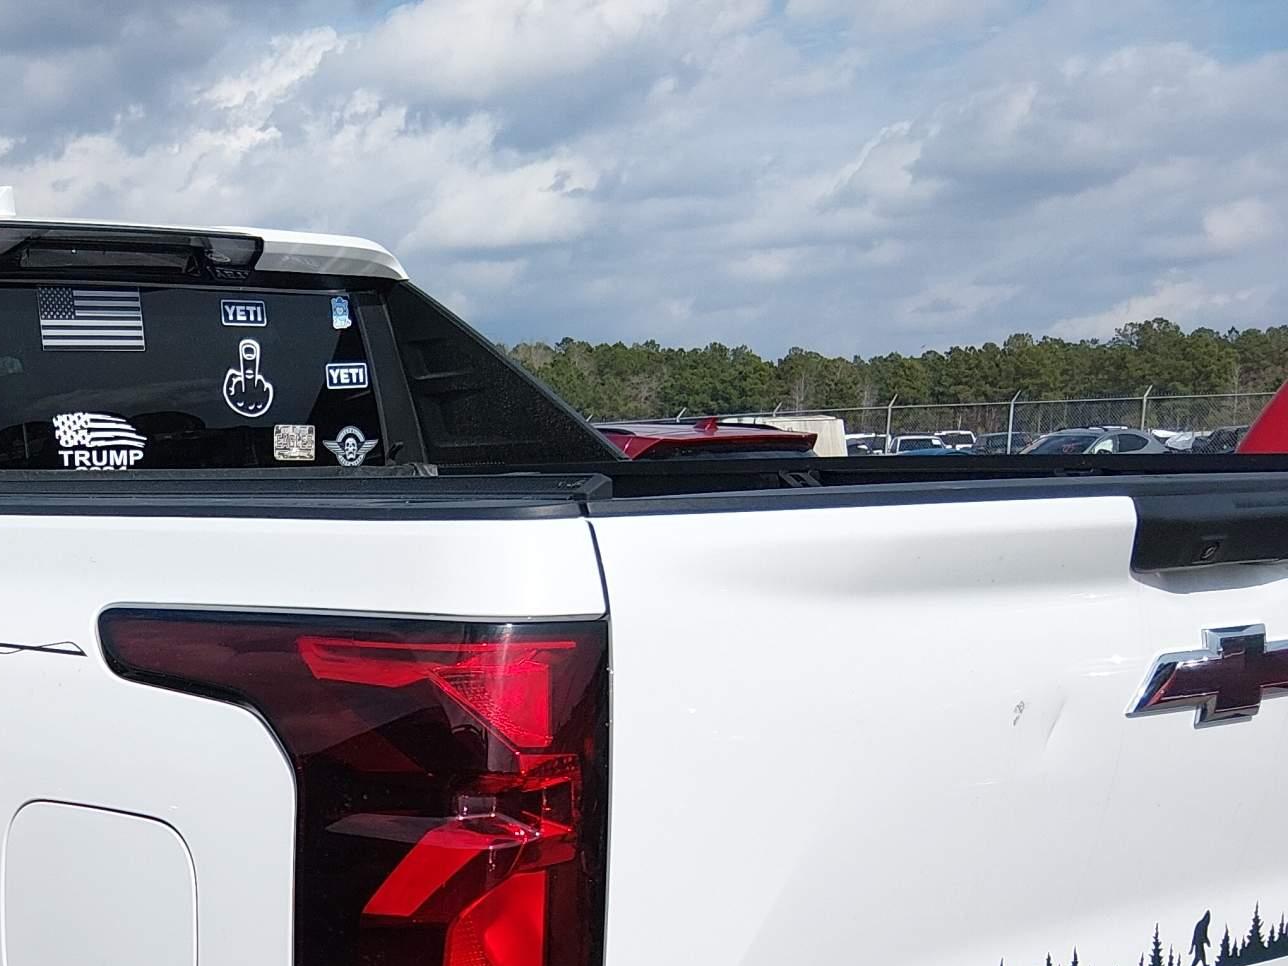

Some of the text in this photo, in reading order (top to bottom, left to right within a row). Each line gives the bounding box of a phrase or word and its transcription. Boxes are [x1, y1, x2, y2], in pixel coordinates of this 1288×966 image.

[224, 305, 262, 322] YETI
[329, 367, 364, 384] YETI
[58, 449, 144, 467] TRUMP
